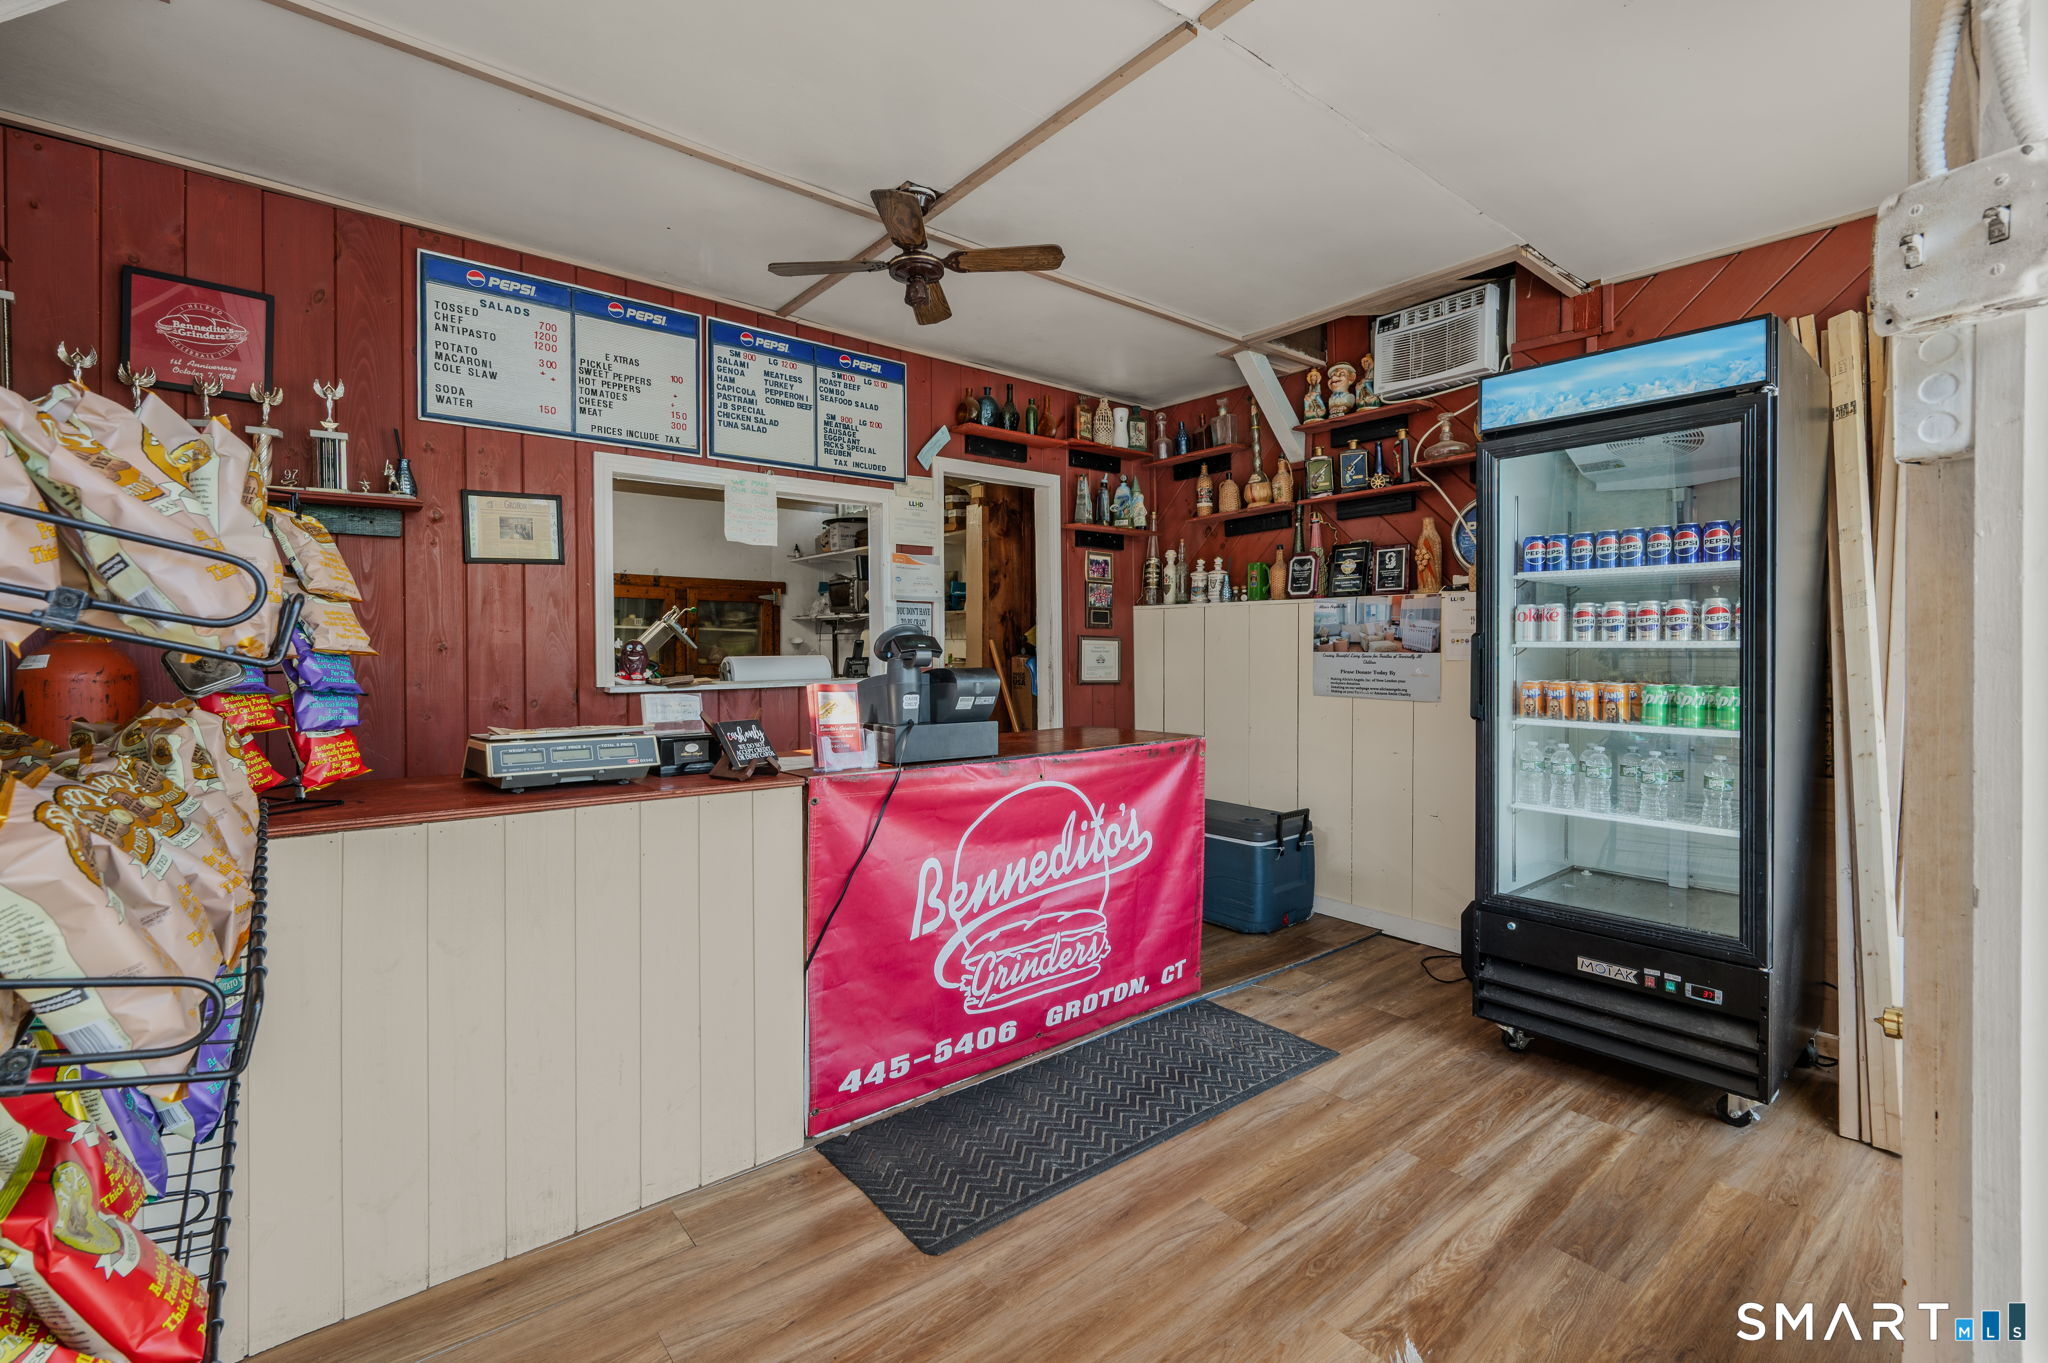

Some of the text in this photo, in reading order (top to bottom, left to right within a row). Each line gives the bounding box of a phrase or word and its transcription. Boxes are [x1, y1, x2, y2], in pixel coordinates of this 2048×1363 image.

[488, 277, 536, 296] PEPSI
[435, 301, 479, 317] TOSSED
[480, 300, 530, 316] SALADS
[434, 312, 463, 324] CHEF
[626, 308, 667, 326] PEPSI
[172, 320, 235, 334] Bennedito's
[435, 323, 497, 341] ANTIPASTO
[178, 330, 226, 340] Grinders
[435, 341, 478, 355] POTATO
[756, 337, 789, 352] PEPSI
[435, 352, 492, 369] MACARONI
[580, 358, 612, 371] PICKLE
[717, 356, 749, 368] SALAMI
[730, 350, 741, 358] SM
[768, 358, 778, 366] LG
[172, 366, 204, 377] October
[187, 360, 238, 373] Anniversary
[434, 362, 498, 380] COLE SLAW
[717, 365, 745, 377] GENOA
[852, 360, 882, 374] PEPSI
[578, 367, 652, 386] SWEET PEPPERS
[718, 375, 735, 383] HAM
[764, 370, 803, 383] MEATLESS
[832, 372, 842, 380] SM
[435, 384, 465, 396] SODA
[579, 377, 641, 393] HOT PEPPERS
[717, 384, 756, 397] CAPICOLA
[764, 379, 794, 390] TURKEY
[819, 378, 861, 391] ROAST BEEF
[819, 386, 845, 396] COMBO
[436, 394, 473, 408] WATER
[579, 387, 628, 401] TOMATOES
[717, 393, 758, 405] PASTRAMI
[765, 388, 808, 402] PEPPERONI
[579, 397, 613, 409] CHEESE
[731, 404, 765, 416] SPECIAL
[765, 397, 812, 411] CORNED BEEF
[820, 395, 879, 411] SEAFOOD SALAD
[580, 407, 602, 417] MEAT
[718, 411, 779, 426] CHICKEN SALAD
[718, 420, 767, 433] TUNA SALAD
[824, 420, 859, 432] MEATBALL
[824, 427, 856, 438] SAUSAGE
[591, 425, 680, 444] PRICES INCLUDE TAX
[824, 434, 860, 445] EGGPLANT
[824, 441, 876, 455] RICKS SPECIAL
[824, 448, 852, 457] REUBEN
[834, 459, 886, 472] TAX INCLUDED
[284, 468, 299, 480] 97
[744, 725, 764, 742] only
[910, 803, 1153, 941] Bennedito's
[972, 932, 1110, 1007] Grinders
[1581, 960, 1632, 981] MOTAK
[1703, 991, 1713, 999] 37
[838, 958, 1187, 1094] 445-5406 GROTON, CT
[100, 1183, 124, 1208] Thick
